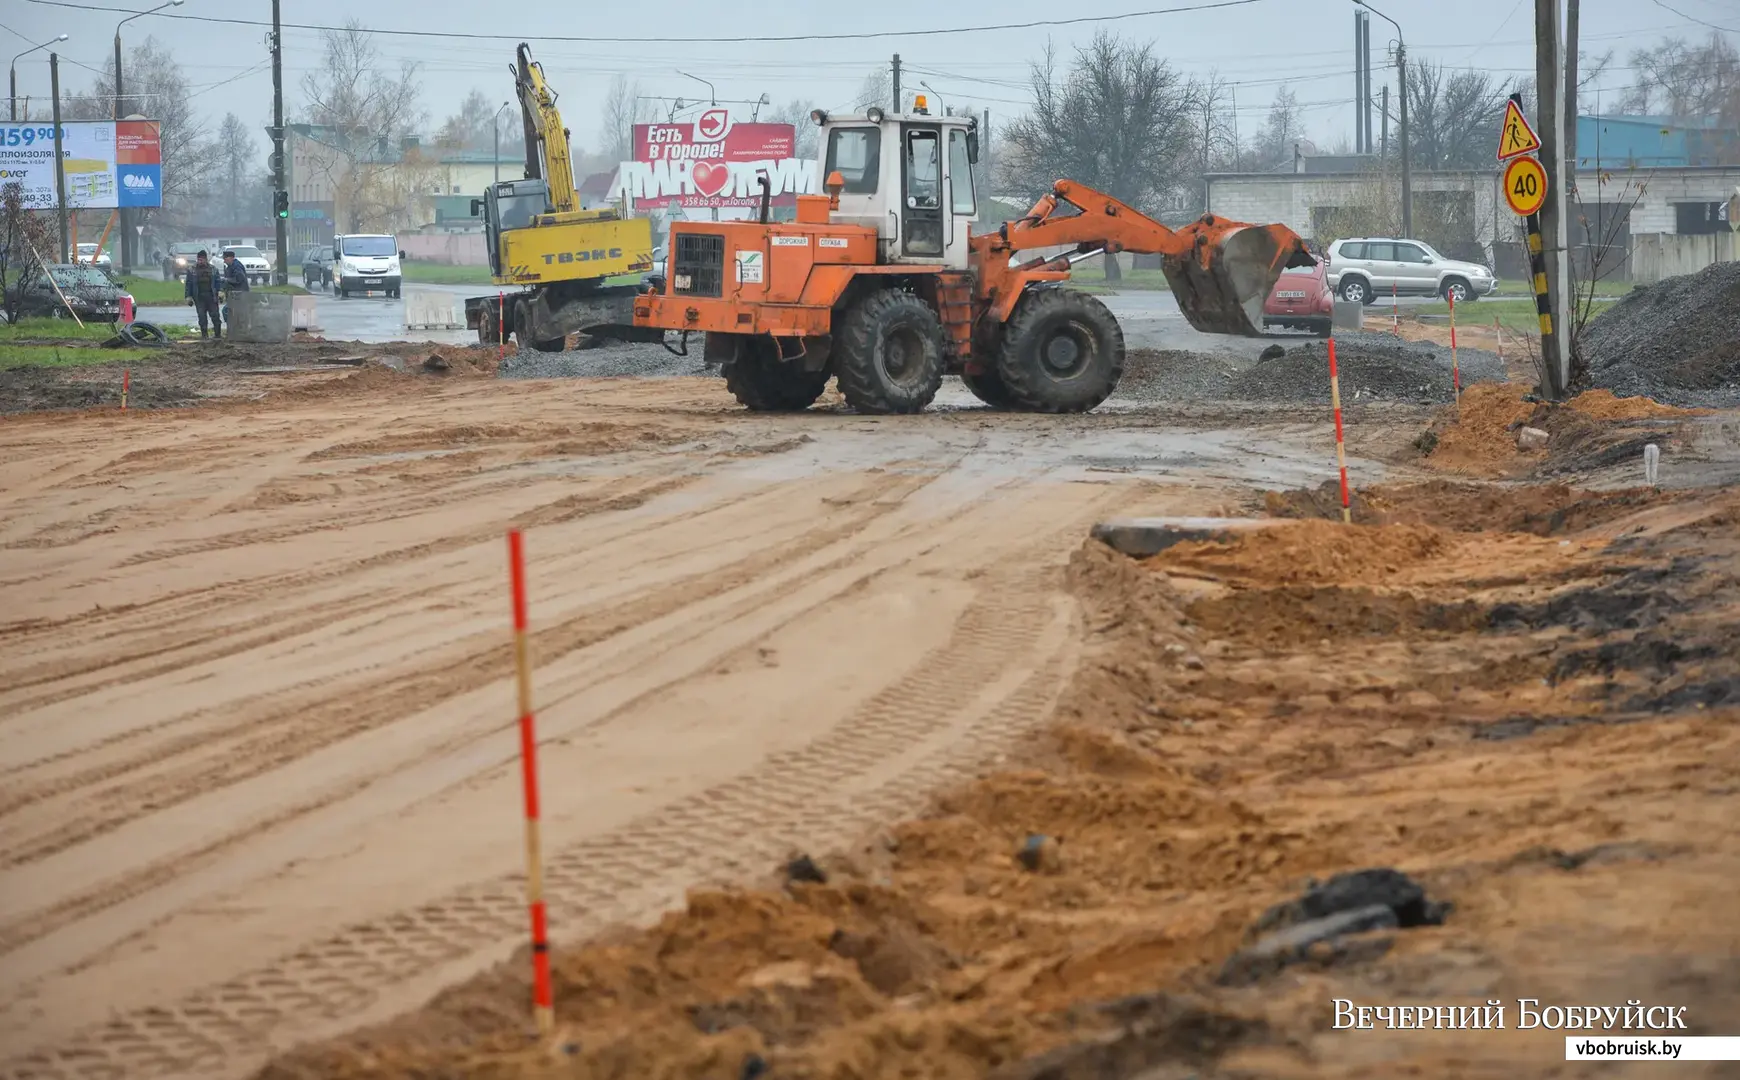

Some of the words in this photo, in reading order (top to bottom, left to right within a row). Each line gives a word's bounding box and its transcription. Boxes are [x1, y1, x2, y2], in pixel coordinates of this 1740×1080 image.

[647, 125, 682, 143] Есть
[649, 144, 659, 159] в
[663, 141, 725, 163] городе!
[1513, 173, 1537, 197] 40
[541, 248, 622, 265] ТВЭКС
